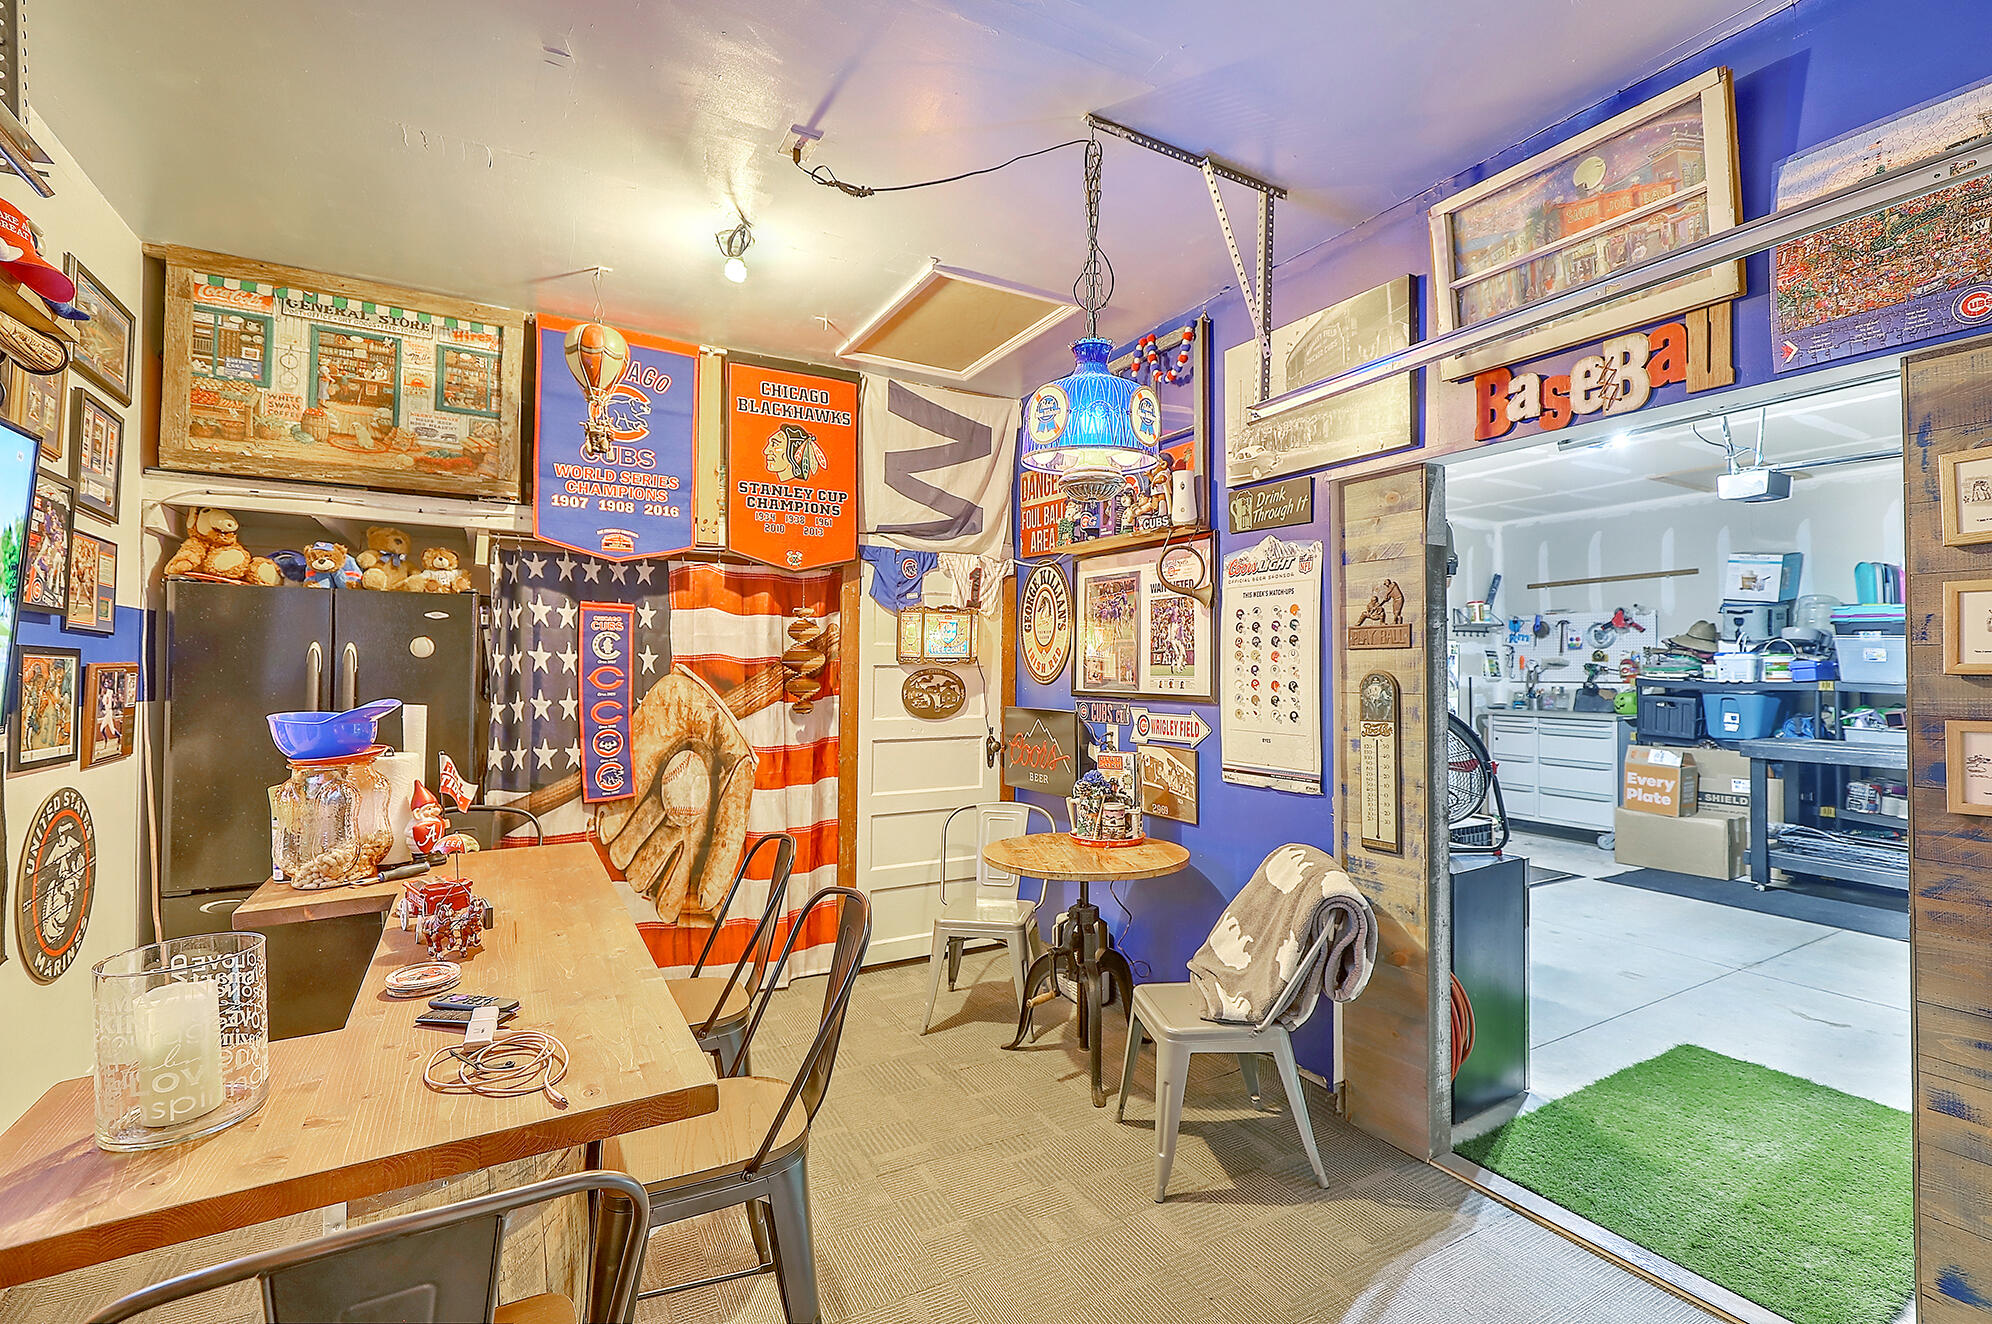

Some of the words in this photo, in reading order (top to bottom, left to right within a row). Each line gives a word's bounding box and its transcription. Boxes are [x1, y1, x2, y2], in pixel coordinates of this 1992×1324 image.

[286, 299, 370, 321] GENERAL
[379, 315, 430, 332] STORE
[760, 380, 830, 406] CHICAGO
[268, 401, 300, 411] SWAN
[736, 397, 852, 427] BLACKHAWKS
[579, 444, 656, 469] CUBS
[553, 462, 617, 483] WORLD
[619, 469, 680, 490] SERIES
[564, 479, 668, 502] CHAMPIONS
[738, 481, 814, 502] STANLEY
[817, 488, 849, 504] CUP
[1257, 486, 1286, 508] Drink
[551, 494, 589, 509] 1907
[598, 499, 635, 514] 1908
[643, 503, 680, 518] 2016
[746, 495, 841, 517] CHAMPIONS
[1252, 498, 1294, 523] Through
[1296, 494, 1309, 513] It
[754, 511, 776, 523] 1934
[785, 514, 806, 525] 1938
[815, 516, 833, 528] 1961
[764, 523, 785, 534] 2010
[802, 526, 824, 537] 2013
[1021, 506, 1042, 531] FOUL
[1143, 515, 1169, 530] CUBS
[1030, 527, 1056, 553] AREA
[1228, 559, 1257, 578] Coors
[1256, 556, 1296, 573] LIGHT
[1300, 561, 1312, 572] NFL
[1024, 577, 1041, 634] GEORGE
[1040, 569, 1066, 631] KILLIAN'S
[591, 621, 624, 631] CUBS
[1351, 630, 1377, 645] PLAY
[1380, 629, 1406, 645] BALL
[1028, 647, 1046, 673] IRISH
[1048, 647, 1062, 670] RED
[1091, 703, 1113, 723] CUBS
[1151, 718, 1179, 736] WRIGLEY
[1180, 720, 1200, 738] FIELD
[1009, 732, 1071, 771] Coors
[1029, 771, 1050, 784] BEER
[1626, 771, 1676, 793] Every
[1626, 788, 1672, 806] Plate
[1705, 794, 1749, 805] SHIELD
[63, 791, 94, 841] STATES
[26, 796, 61, 875] UNITED
[417, 824, 438, 847] A
[441, 839, 463, 848] BEER
[34, 914, 88, 977] MARINES
